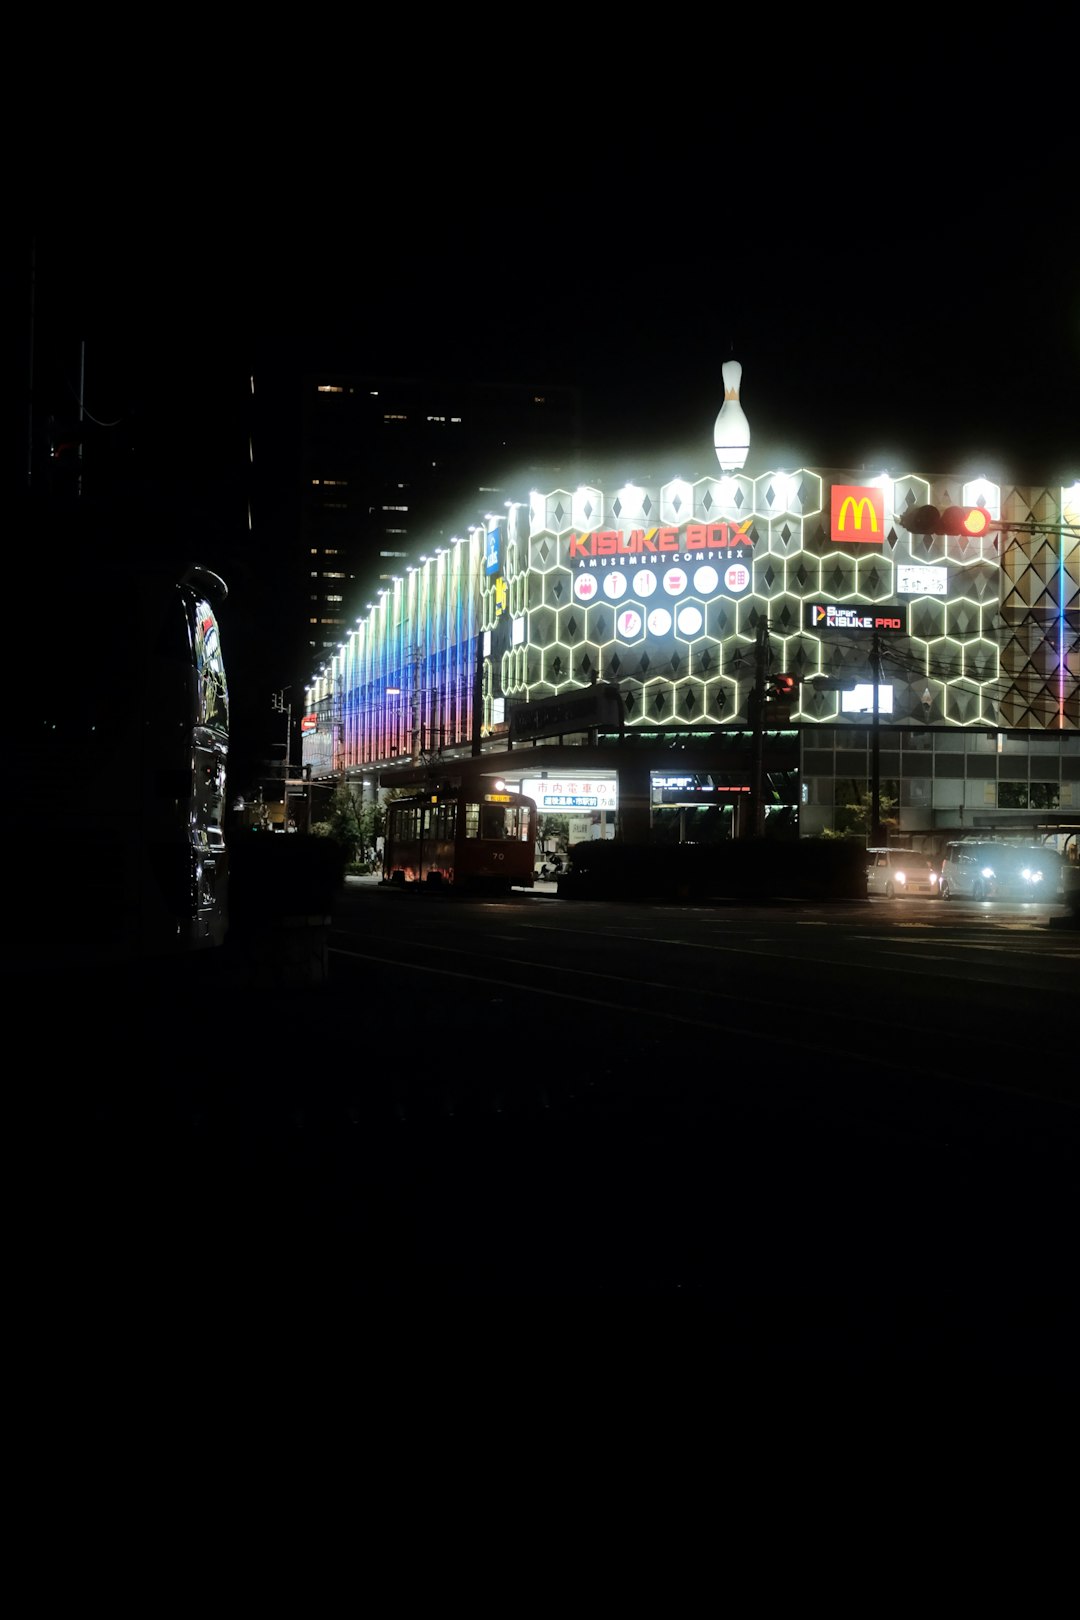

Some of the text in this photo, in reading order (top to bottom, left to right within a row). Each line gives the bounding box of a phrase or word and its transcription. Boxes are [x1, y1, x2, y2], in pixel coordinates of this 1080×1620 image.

[570, 519, 754, 559] KISUKE BOX
[579, 549, 744, 568] AMUSEMENT COMPLEX
[826, 616, 901, 629] KISUKE PRO
[492, 852, 505, 861] 70
